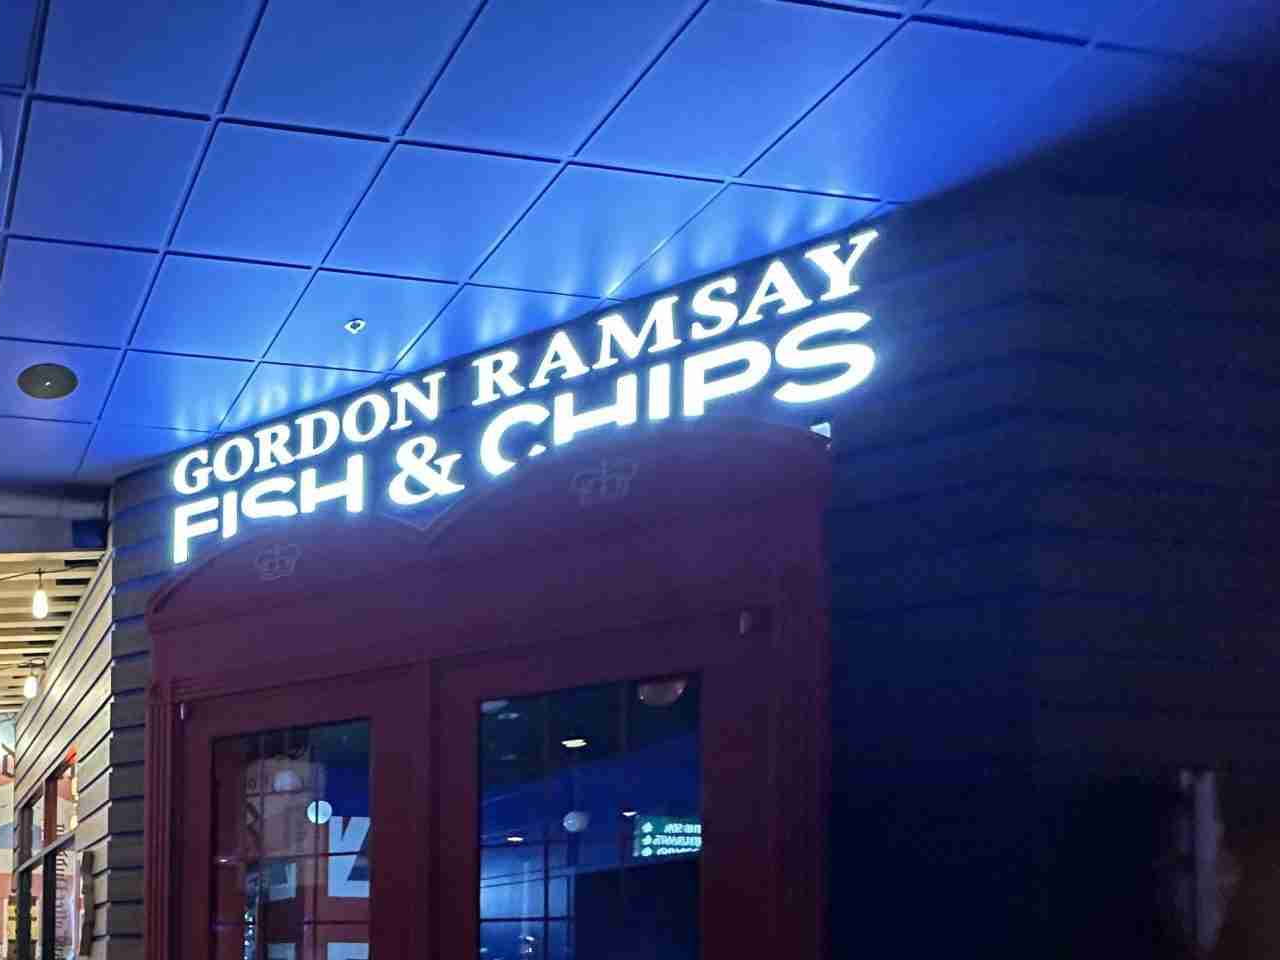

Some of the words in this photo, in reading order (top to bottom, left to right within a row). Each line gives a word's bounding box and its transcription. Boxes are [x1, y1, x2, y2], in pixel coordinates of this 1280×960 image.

[172, 452, 364, 564] FISH
[388, 435, 466, 506] &
[480, 311, 877, 478] CHIPS
[173, 371, 448, 496] GORDON
[471, 230, 879, 407] RAMSAY
